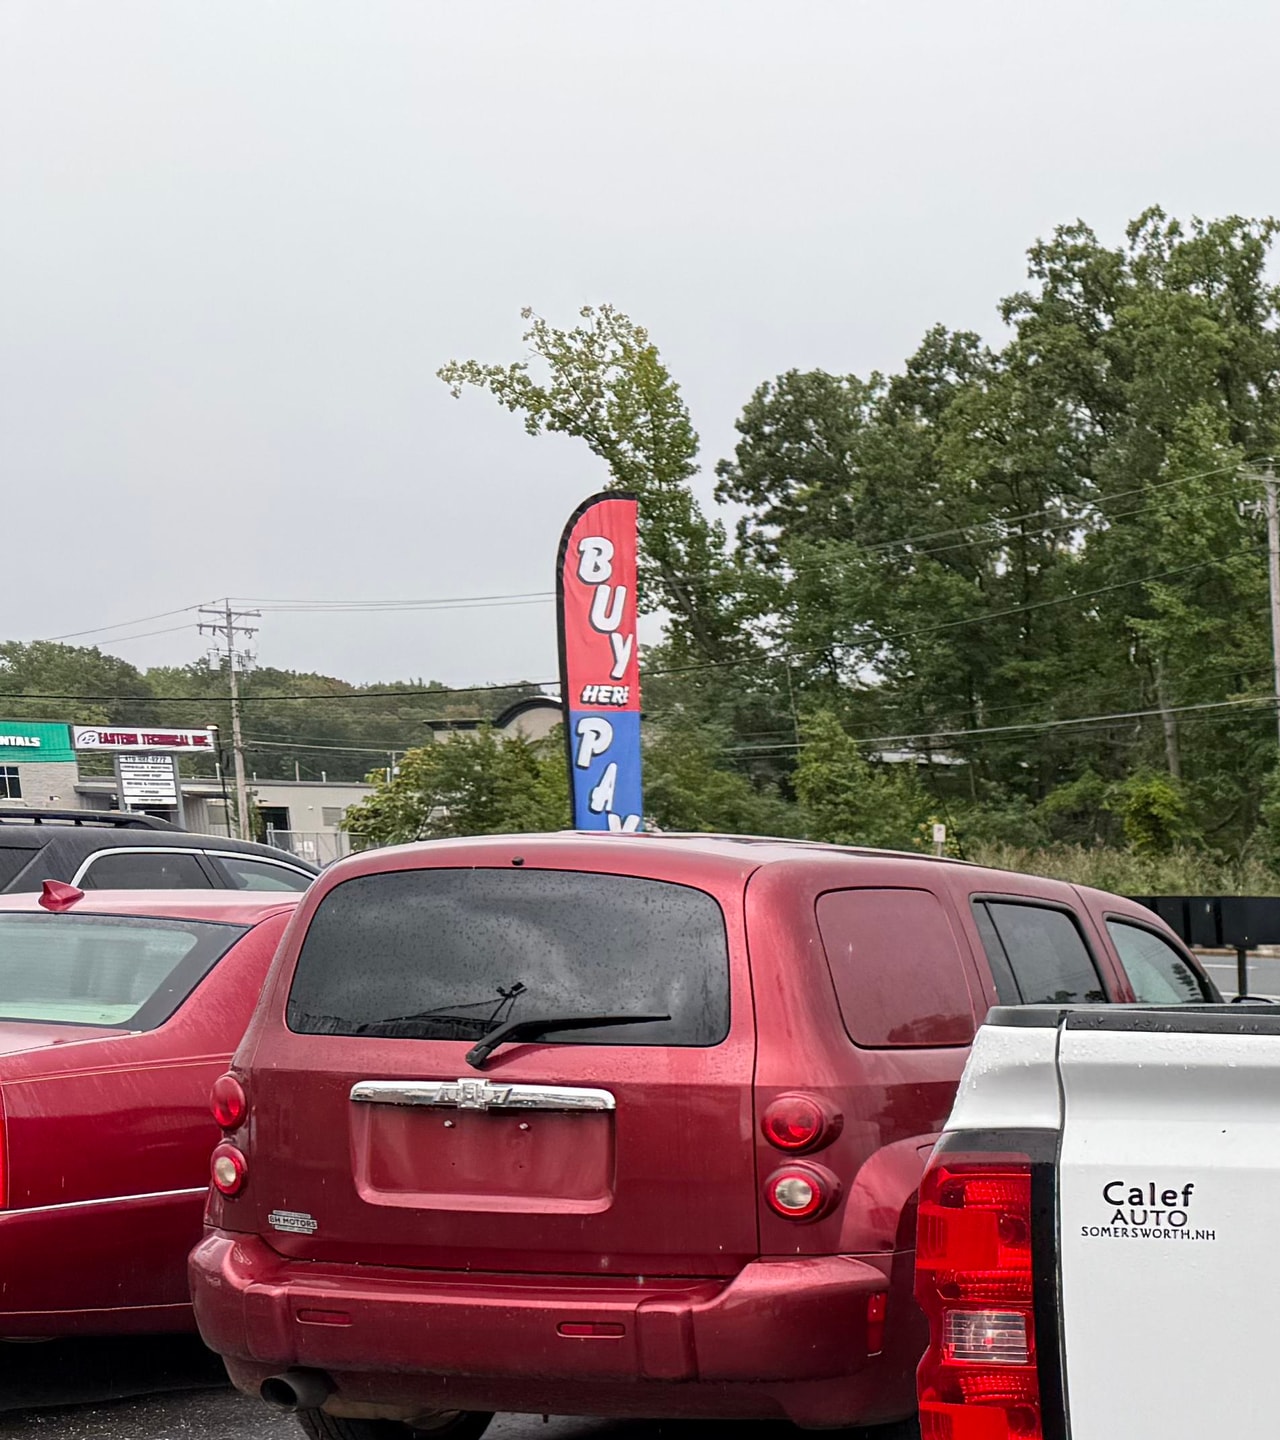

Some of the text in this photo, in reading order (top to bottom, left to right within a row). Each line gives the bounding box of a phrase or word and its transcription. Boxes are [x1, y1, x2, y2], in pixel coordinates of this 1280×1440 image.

[577, 536, 634, 680] BUY
[580, 684, 630, 706] HERE
[1102, 1181, 1195, 1207] Calef
[283, 1218, 316, 1228] MOTORS
[1110, 1209, 1188, 1227] AUTO
